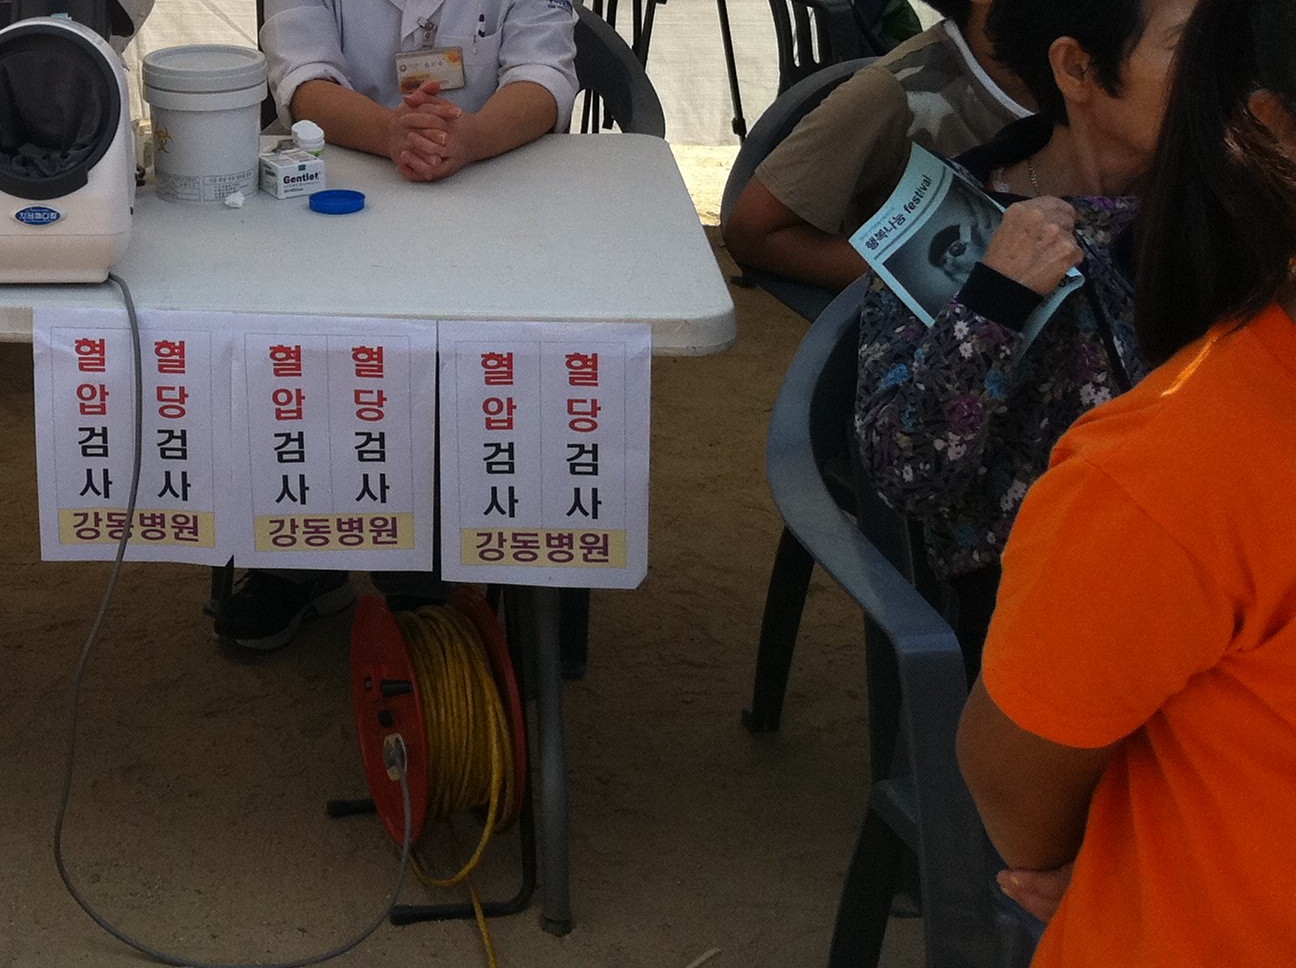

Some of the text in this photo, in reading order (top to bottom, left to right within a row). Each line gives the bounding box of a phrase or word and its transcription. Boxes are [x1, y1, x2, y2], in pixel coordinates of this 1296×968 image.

[865, 213, 906, 250] 행복나눔
[903, 174, 933, 214] festival
[74, 337, 113, 501] 혈압검사
[153, 338, 192, 502] 혈당검사
[268, 343, 309, 506] 혈압검사
[350, 345, 391, 505] 혈당검사
[480, 351, 519, 520] 혈압검사
[564, 351, 603, 521] 혈당검사
[72, 511, 201, 543] 강동병원
[268, 515, 400, 548] 강동병원
[475, 530, 611, 564] 강동병원
